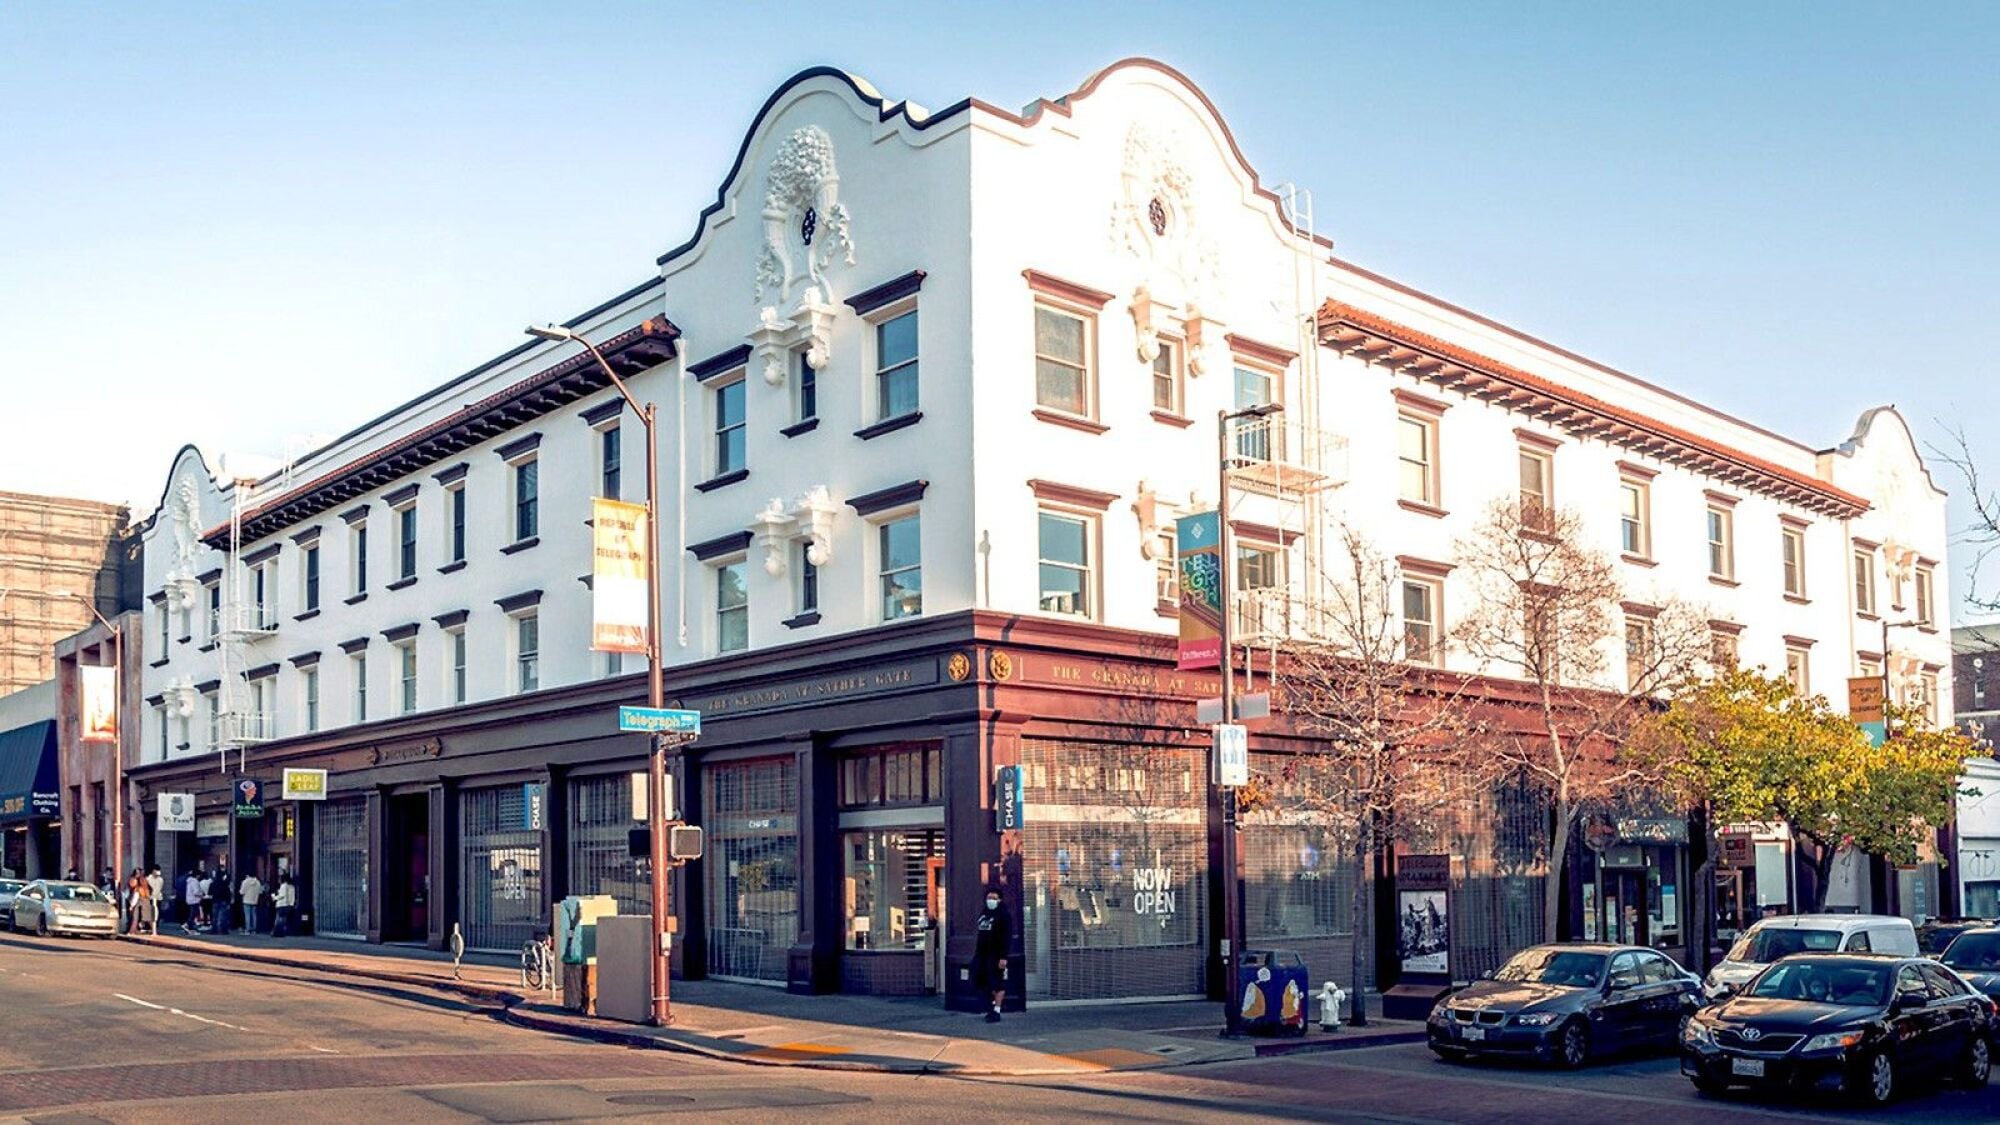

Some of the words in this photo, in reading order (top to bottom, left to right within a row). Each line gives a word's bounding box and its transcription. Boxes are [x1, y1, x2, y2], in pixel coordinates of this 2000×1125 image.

[1053, 666, 1080, 679] THE
[1092, 670, 1159, 686] GRANADA
[1168, 679, 1184, 690] AT
[623, 711, 681, 730] Telegraph
[532, 795, 541, 832] CHASE
[1004, 782, 1015, 828] CHASE
[1133, 868, 1171, 891] NOW
[1134, 891, 1175, 915] OPEN
